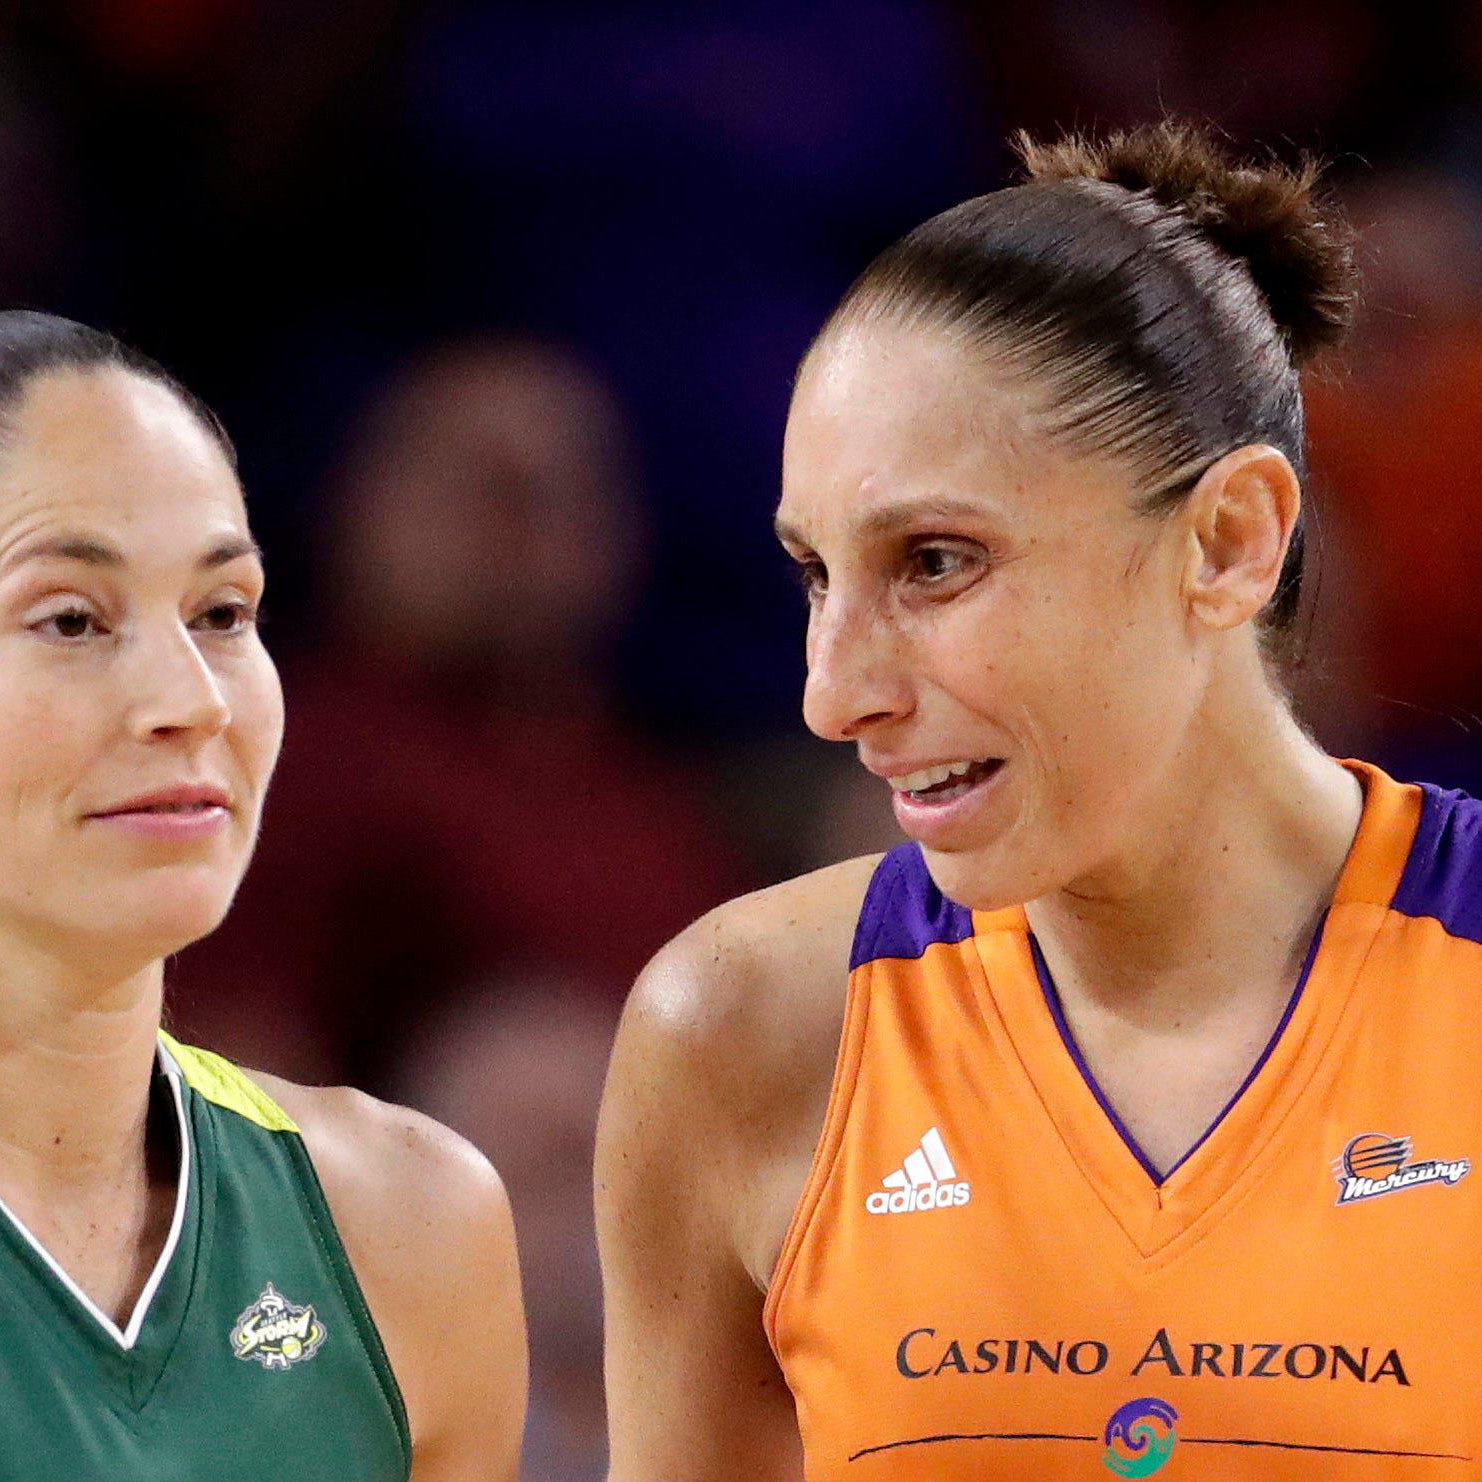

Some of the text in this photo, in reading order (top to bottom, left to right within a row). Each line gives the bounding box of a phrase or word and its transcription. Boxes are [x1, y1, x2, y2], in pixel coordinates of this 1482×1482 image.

[865, 1180, 971, 1214] adidas
[1342, 1161, 1468, 1201] Mercury
[896, 1327, 1411, 1387] CASINO ARIZONA
